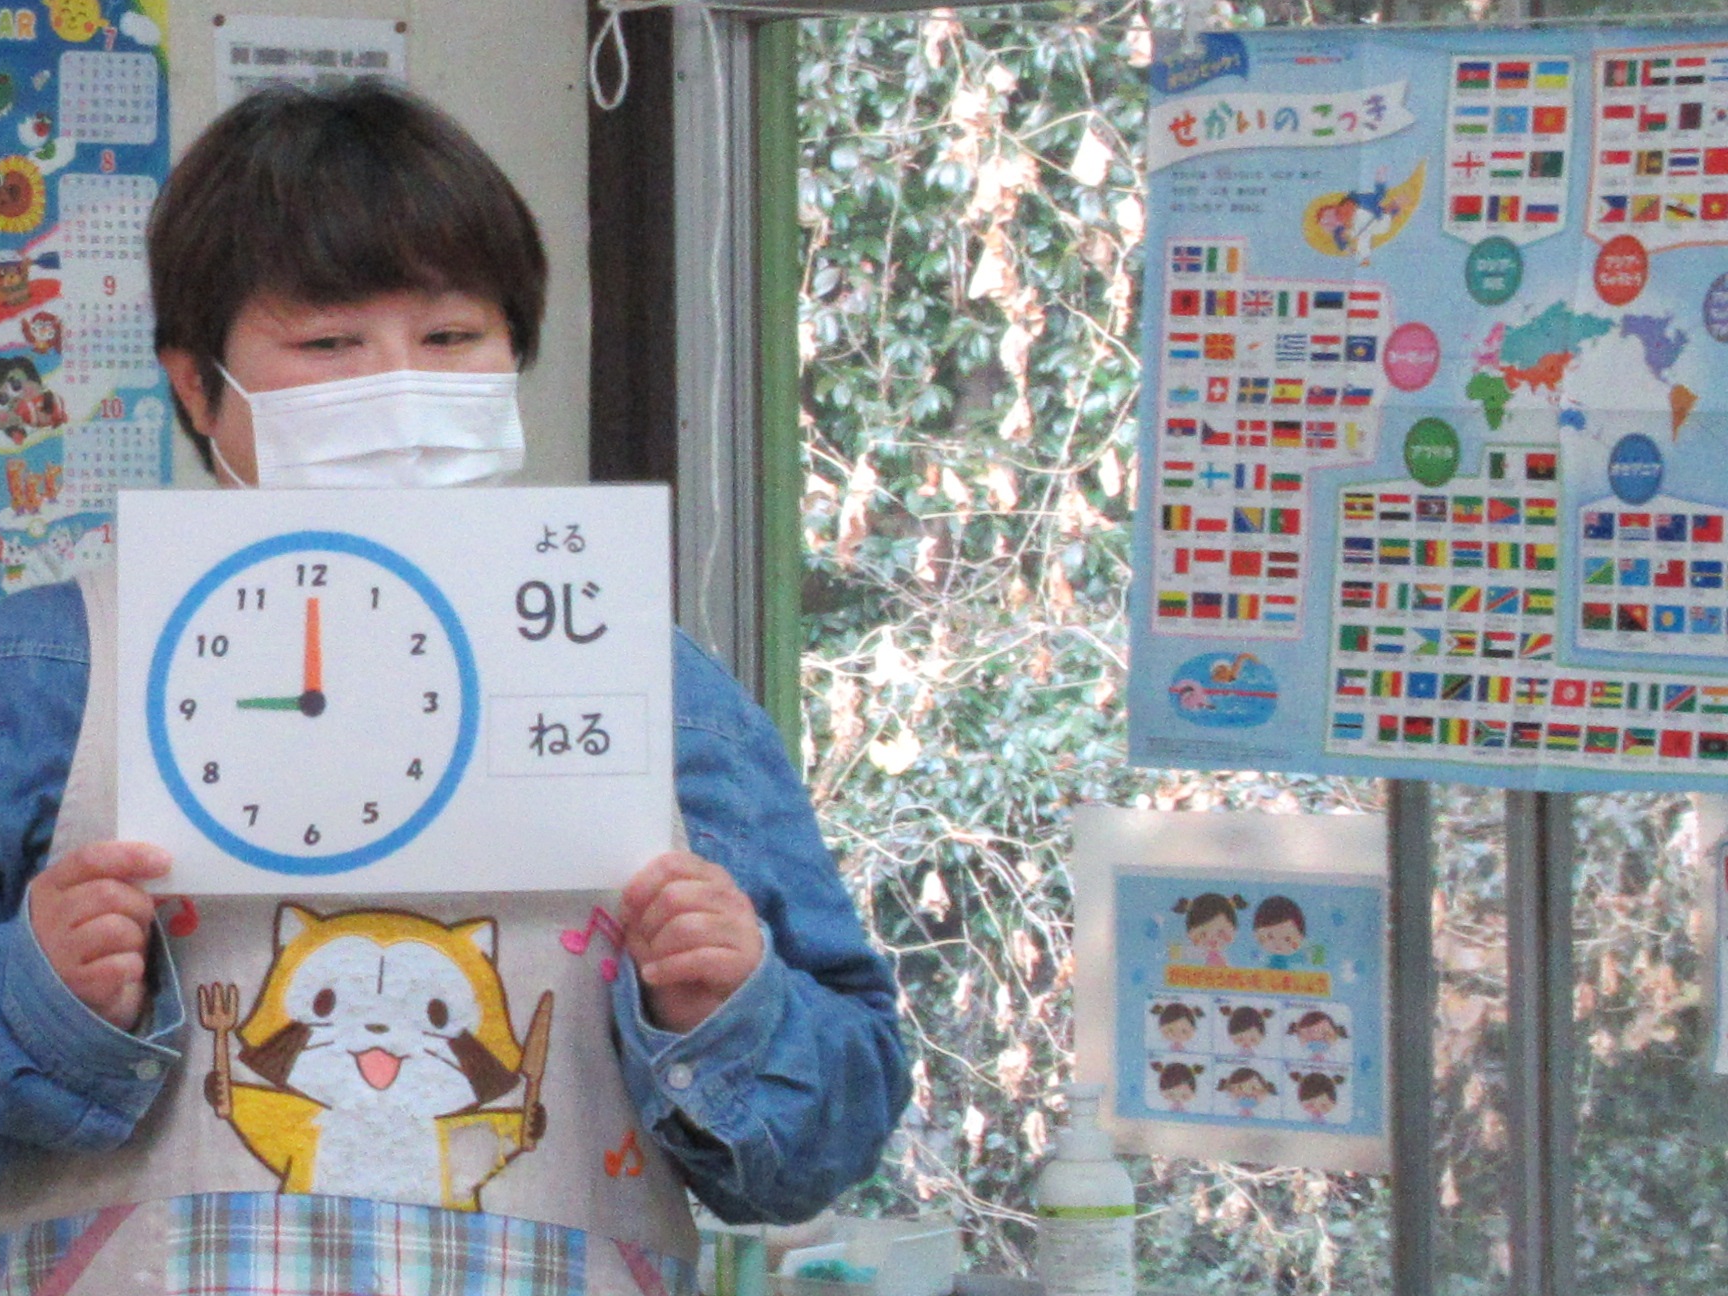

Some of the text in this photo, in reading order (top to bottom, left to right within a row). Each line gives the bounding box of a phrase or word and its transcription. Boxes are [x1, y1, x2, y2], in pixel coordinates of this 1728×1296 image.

[1167, 94, 1388, 148] せかいのこっき
[534, 523, 586, 554] よる
[295, 563, 328, 587] 12
[236, 586, 266, 610] 11
[369, 586, 380, 609] 1
[514, 579, 607, 645] 9じ
[195, 633, 230, 658] 10
[410, 632, 428, 656] 2
[178, 697, 197, 720] 9
[423, 690, 439, 714] 3
[529, 711, 611, 757] ねる
[201, 760, 221, 785] 8
[405, 757, 423, 780] 4
[242, 804, 260, 826] 7
[362, 800, 380, 825] 5
[302, 822, 322, 846] 6
